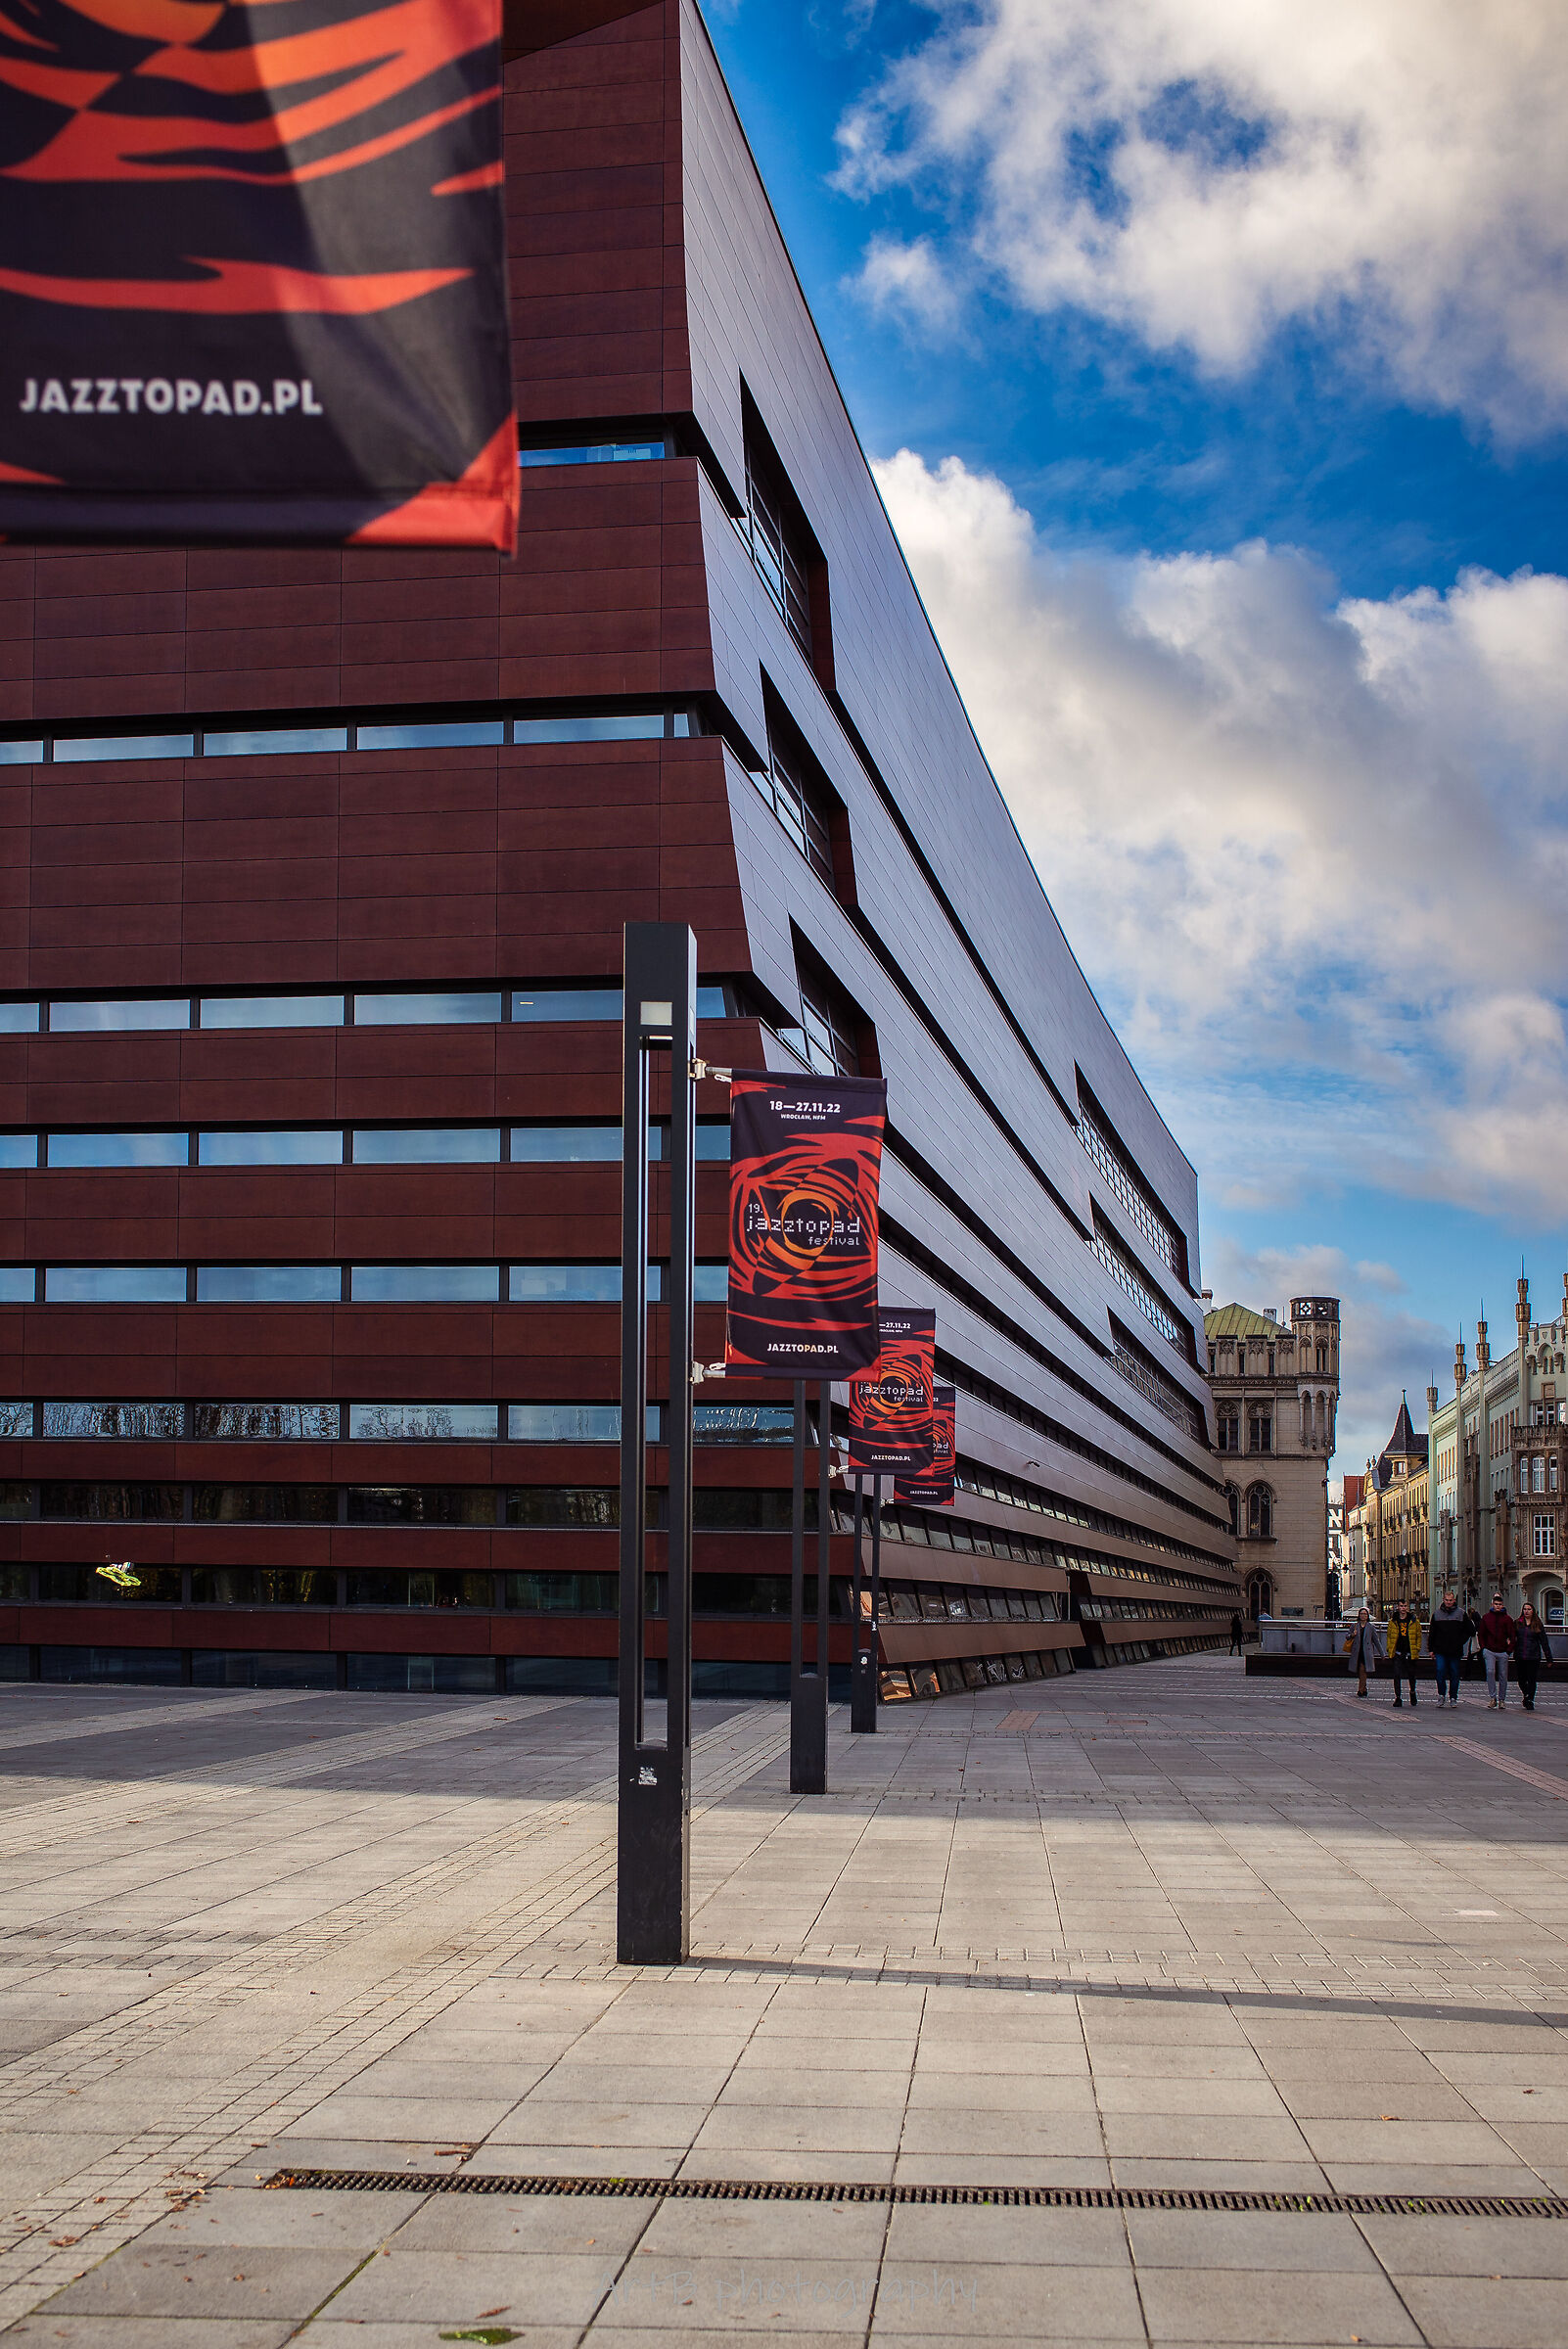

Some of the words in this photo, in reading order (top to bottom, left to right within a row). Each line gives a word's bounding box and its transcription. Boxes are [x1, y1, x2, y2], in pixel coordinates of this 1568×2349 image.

[20, 378, 323, 416] JAZZTOPAD.PL
[748, 1203, 763, 1214] 19.
[746, 1216, 860, 1234] jazztopad
[808, 1236, 860, 1246] festival
[767, 1343, 839, 1354] JAZZTOPAD.PL
[858, 1385, 924, 1396] jazztopad
